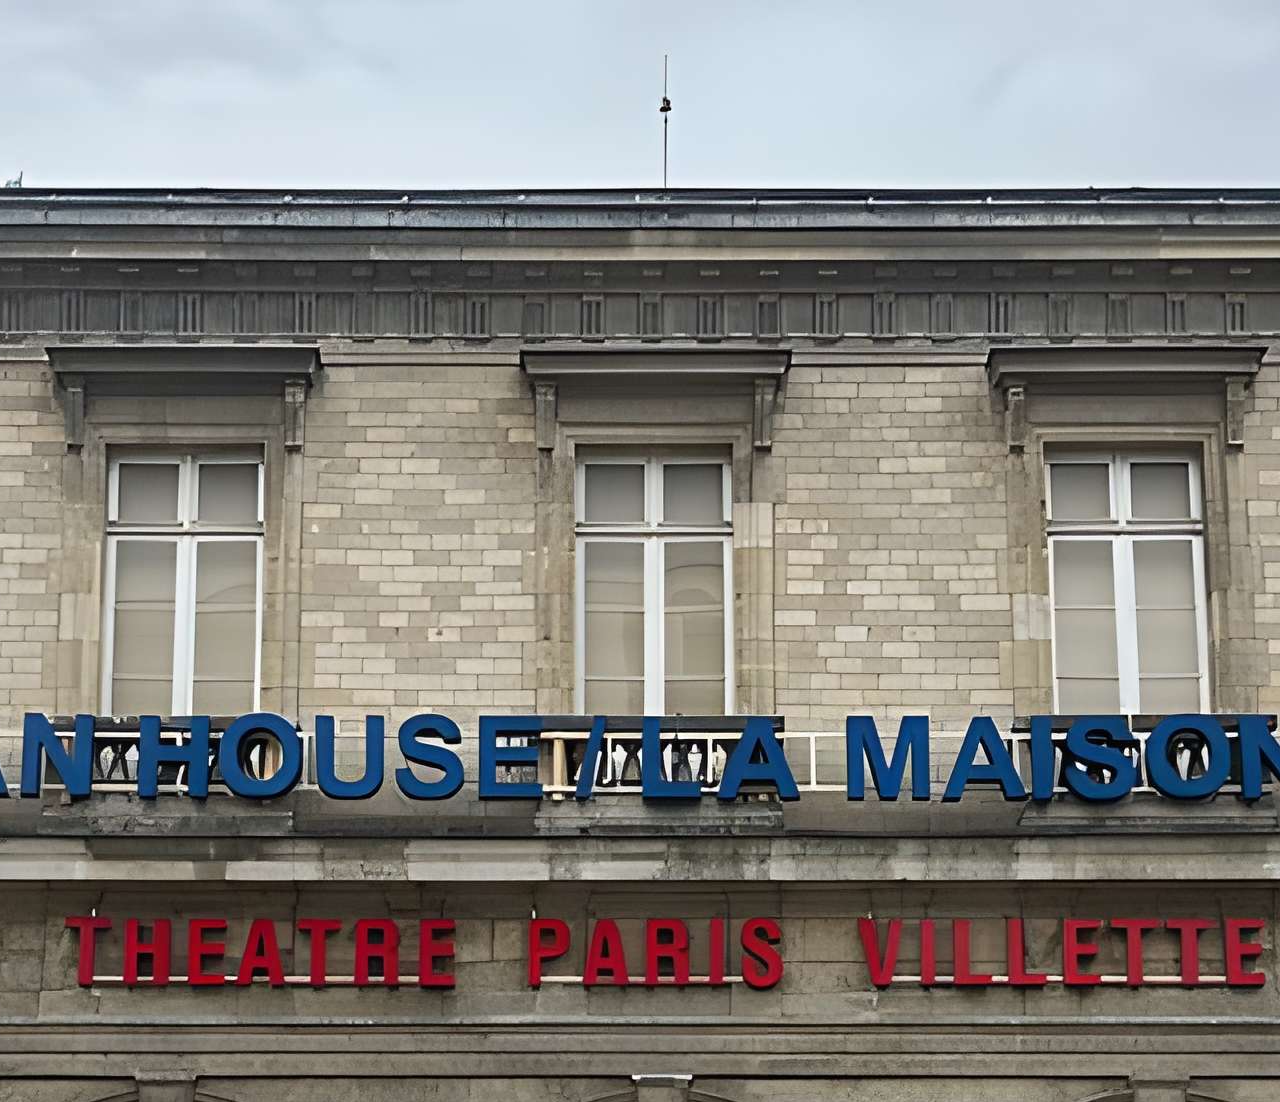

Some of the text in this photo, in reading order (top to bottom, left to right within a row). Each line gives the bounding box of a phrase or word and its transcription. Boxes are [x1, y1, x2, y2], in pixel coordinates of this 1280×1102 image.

[137, 712, 545, 799] HOUSE
[574, 716, 608, 798] /
[641, 716, 800, 801] LA
[64, 916, 1266, 989] THEATRE PARIS VILLETTE
